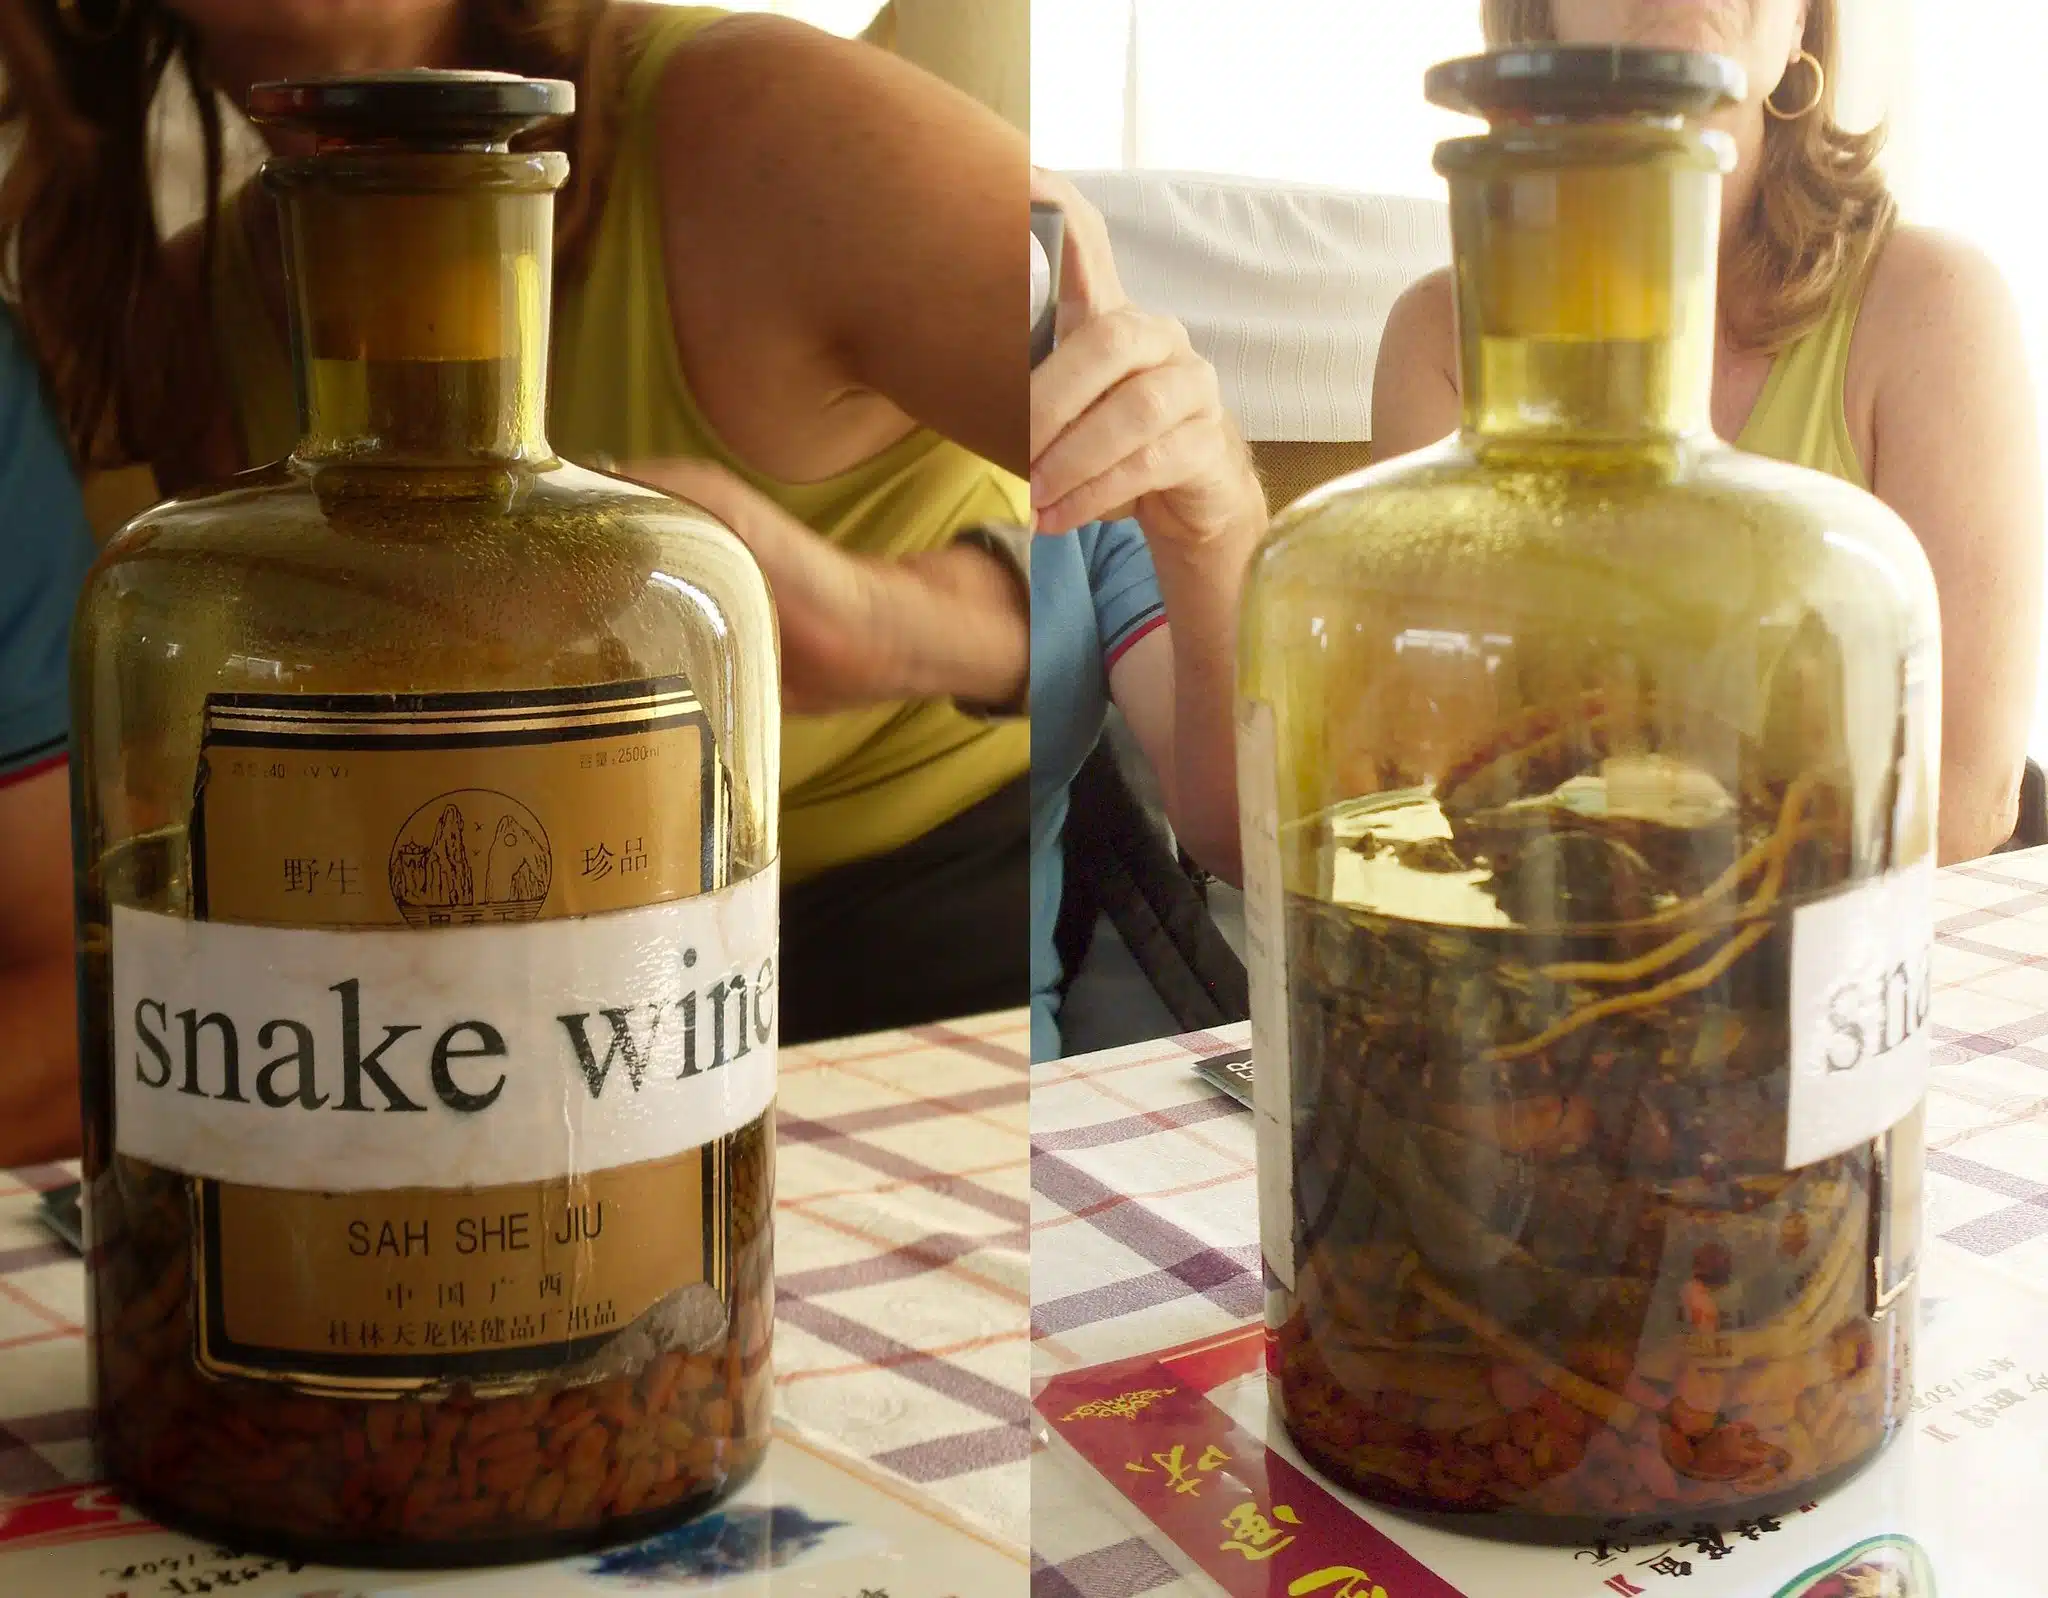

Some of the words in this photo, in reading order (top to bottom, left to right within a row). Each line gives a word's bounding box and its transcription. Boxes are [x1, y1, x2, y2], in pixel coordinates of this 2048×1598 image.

[283, 857, 363, 896] 野生
[581, 836, 649, 882] 珍品
[134, 977, 510, 1114] snake
[556, 946, 774, 1100] wine
[347, 1219, 429, 1257] SAH
[455, 1212, 530, 1255] SHE
[554, 1201, 603, 1245] JIU
